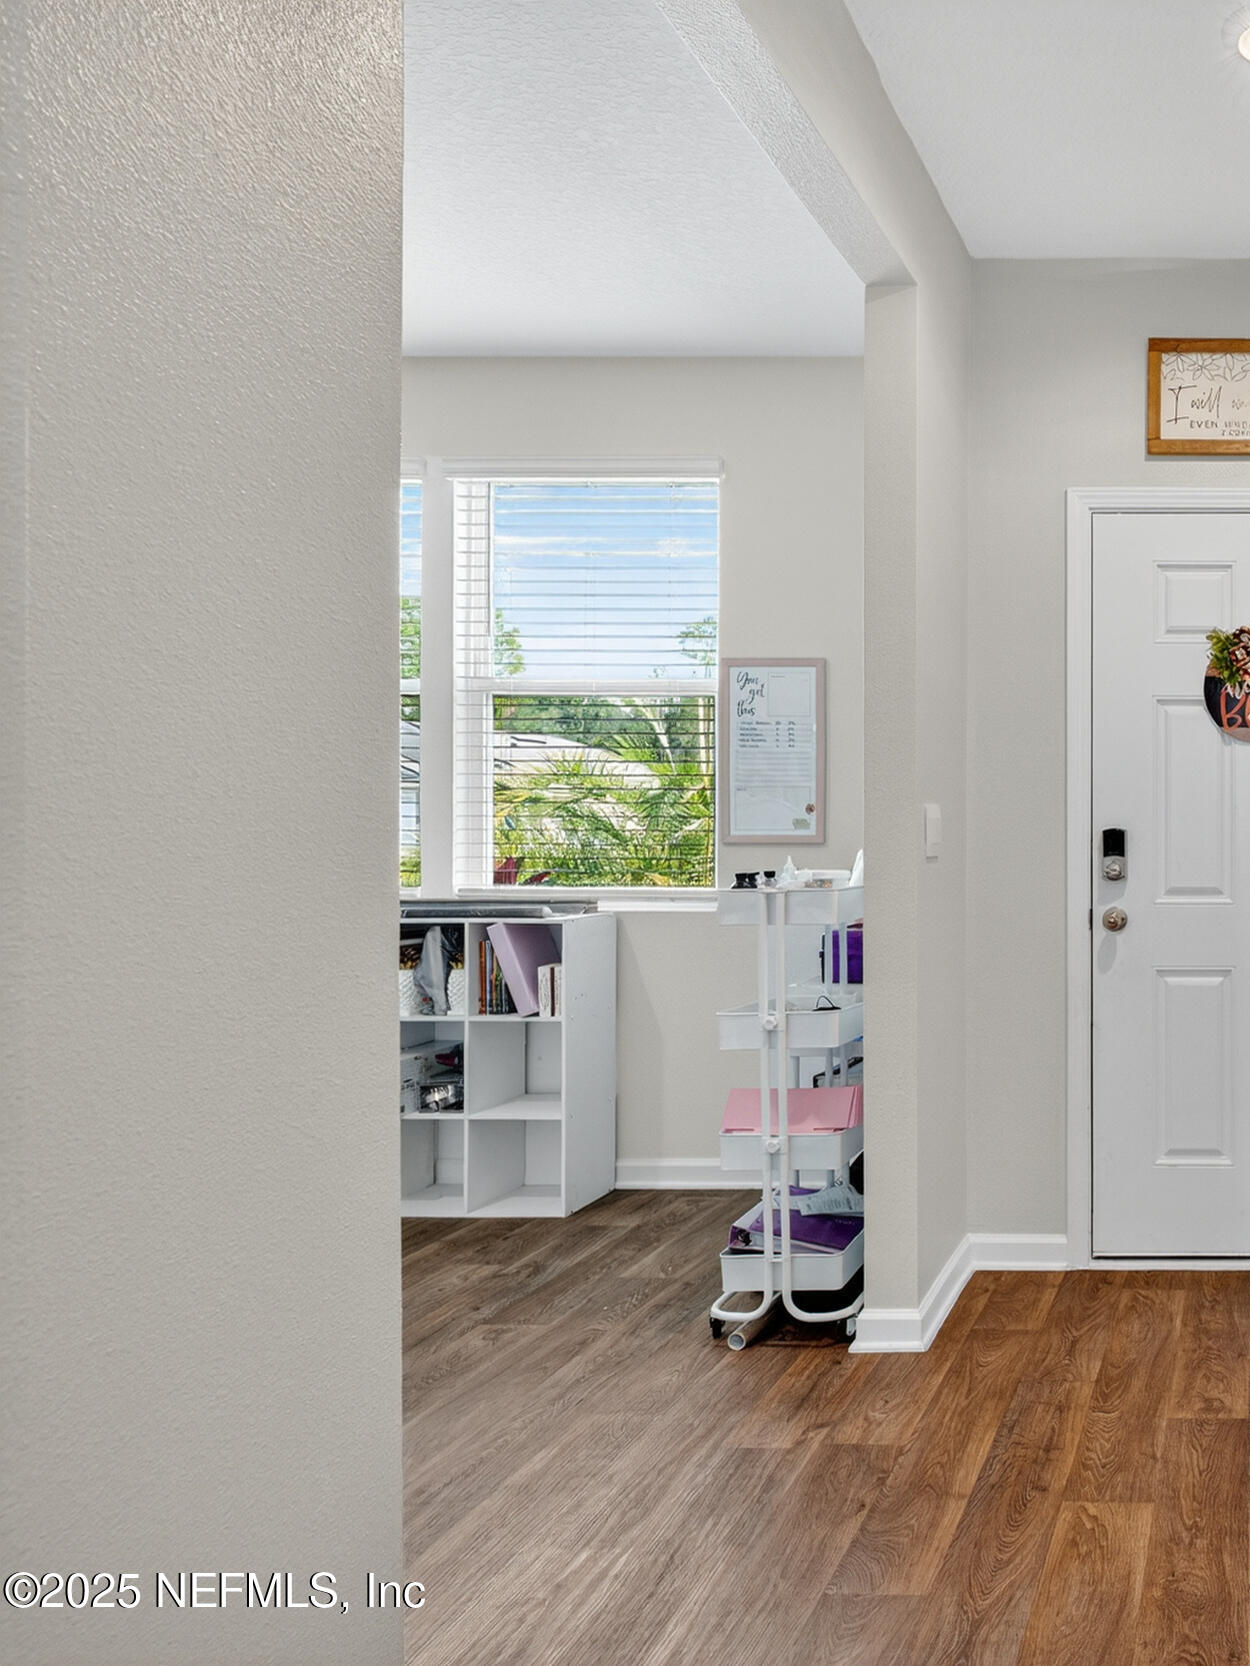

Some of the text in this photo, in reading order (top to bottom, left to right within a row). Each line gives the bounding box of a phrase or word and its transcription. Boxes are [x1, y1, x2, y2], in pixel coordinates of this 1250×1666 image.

[1166, 385, 1198, 424] I
[1190, 386, 1223, 419] will
[1189, 419, 1219, 429] EVEN
[736, 671, 759, 690] You
[748, 683, 766, 706] got
[736, 699, 756, 718] this
